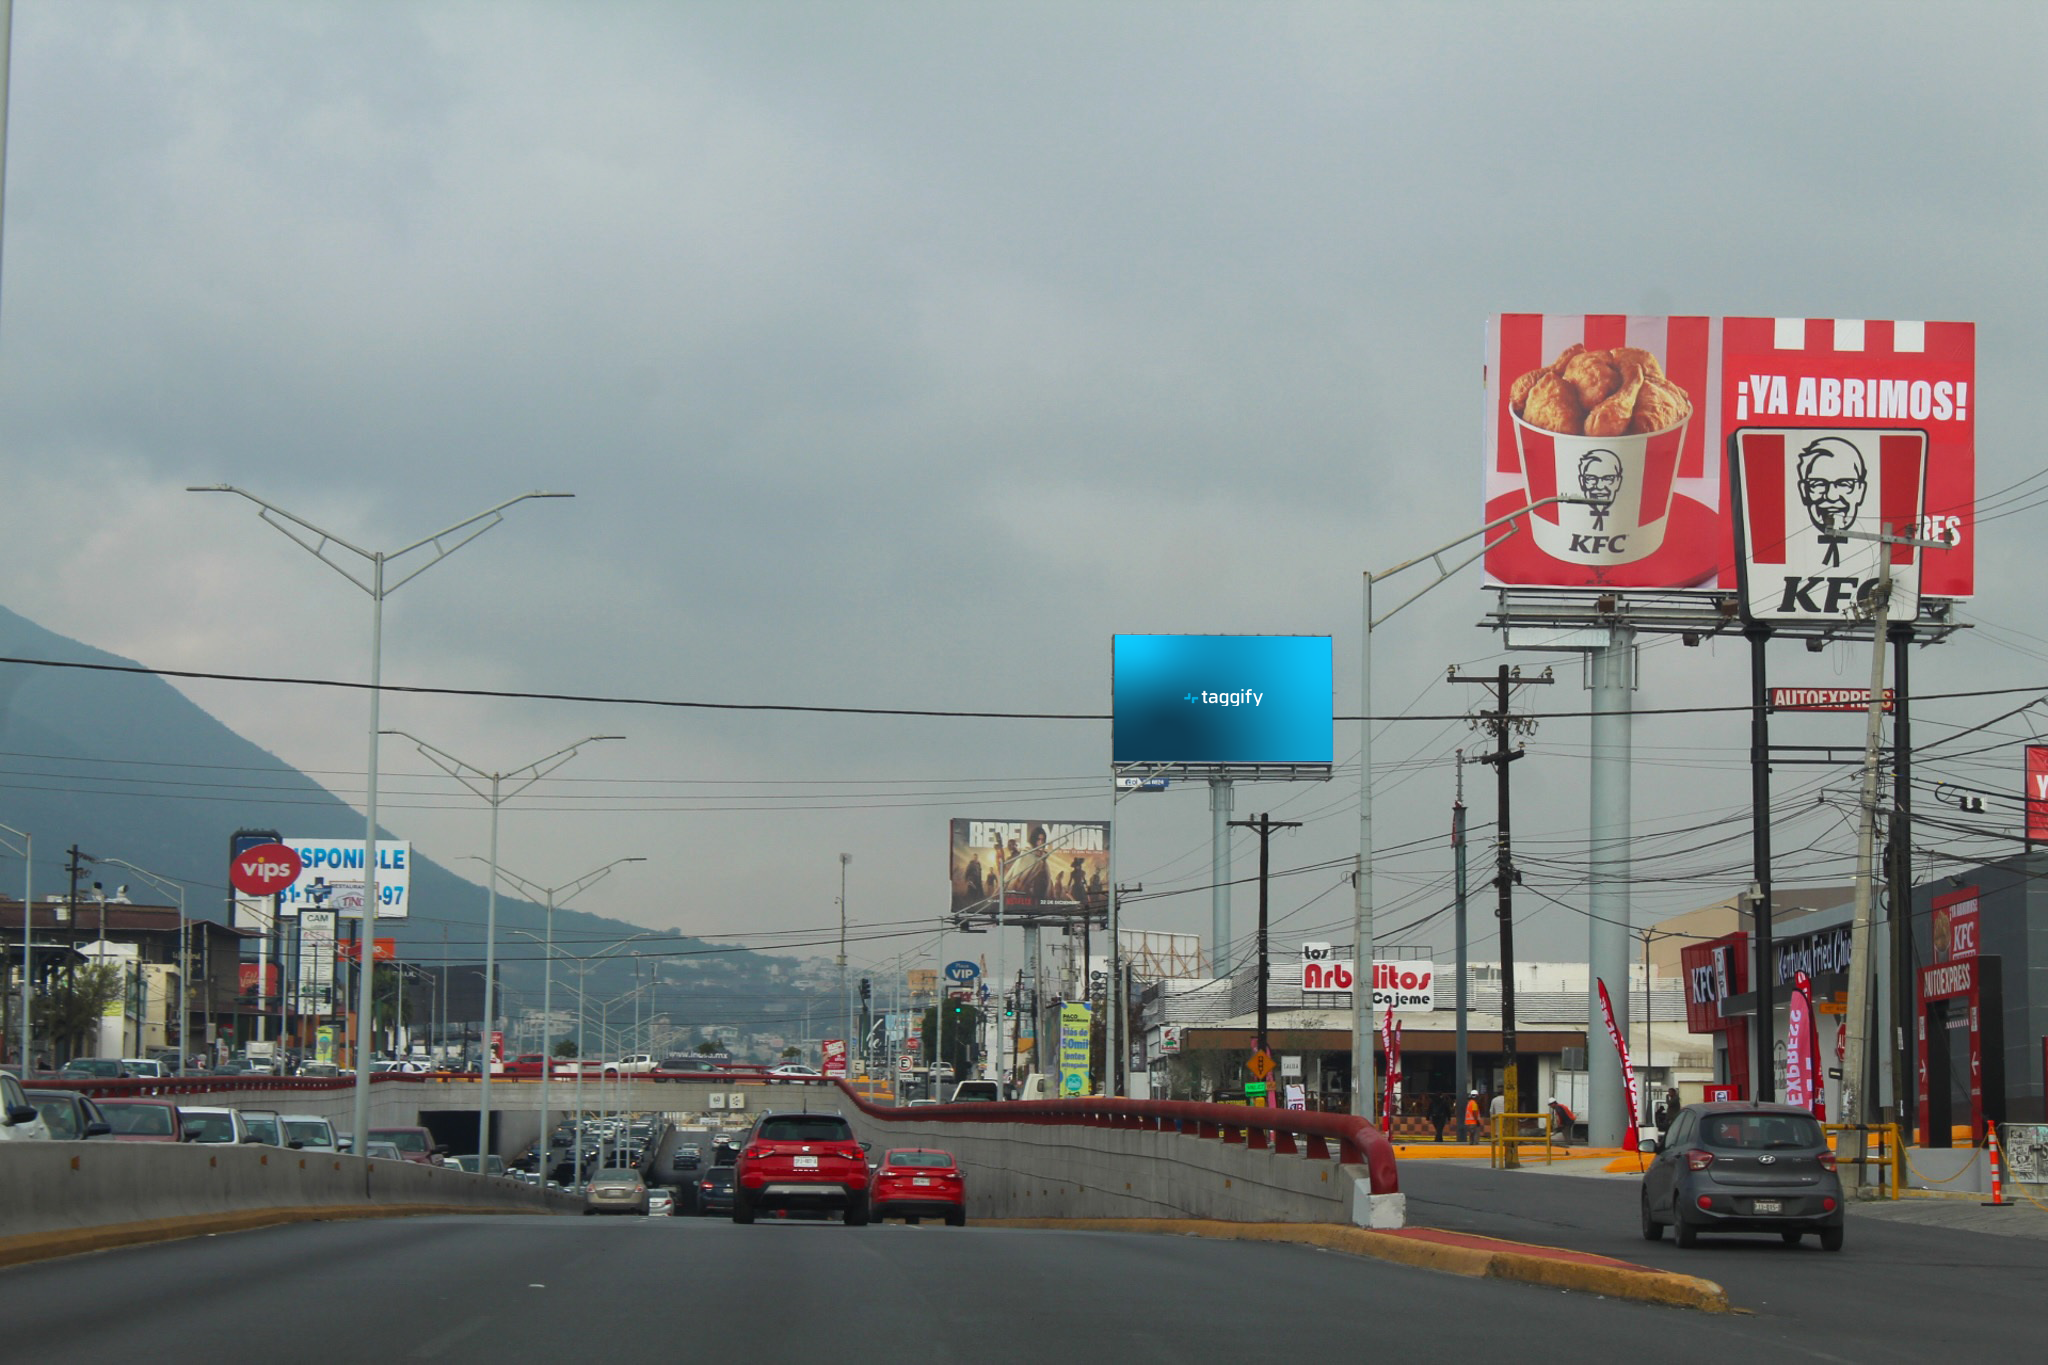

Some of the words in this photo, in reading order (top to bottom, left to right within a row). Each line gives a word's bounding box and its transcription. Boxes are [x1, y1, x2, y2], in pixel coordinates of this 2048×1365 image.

[1736, 375, 1788, 420] ¡YA
[1795, 377, 1967, 421] ABRIMOS!
[1569, 534, 1627, 554] KFC
[1201, 689, 1264, 707] taggify
[1775, 690, 1891, 708] AUTOEXPRES
[242, 856, 290, 883] vips
[307, 914, 329, 922] CAM
[1954, 921, 1975, 952] KFC
[951, 969, 974, 979] VIP
[1304, 963, 1431, 990] Arblitos
[1691, 966, 1715, 1004] KFC
[1924, 963, 1971, 998] AUTOEXPRESS
